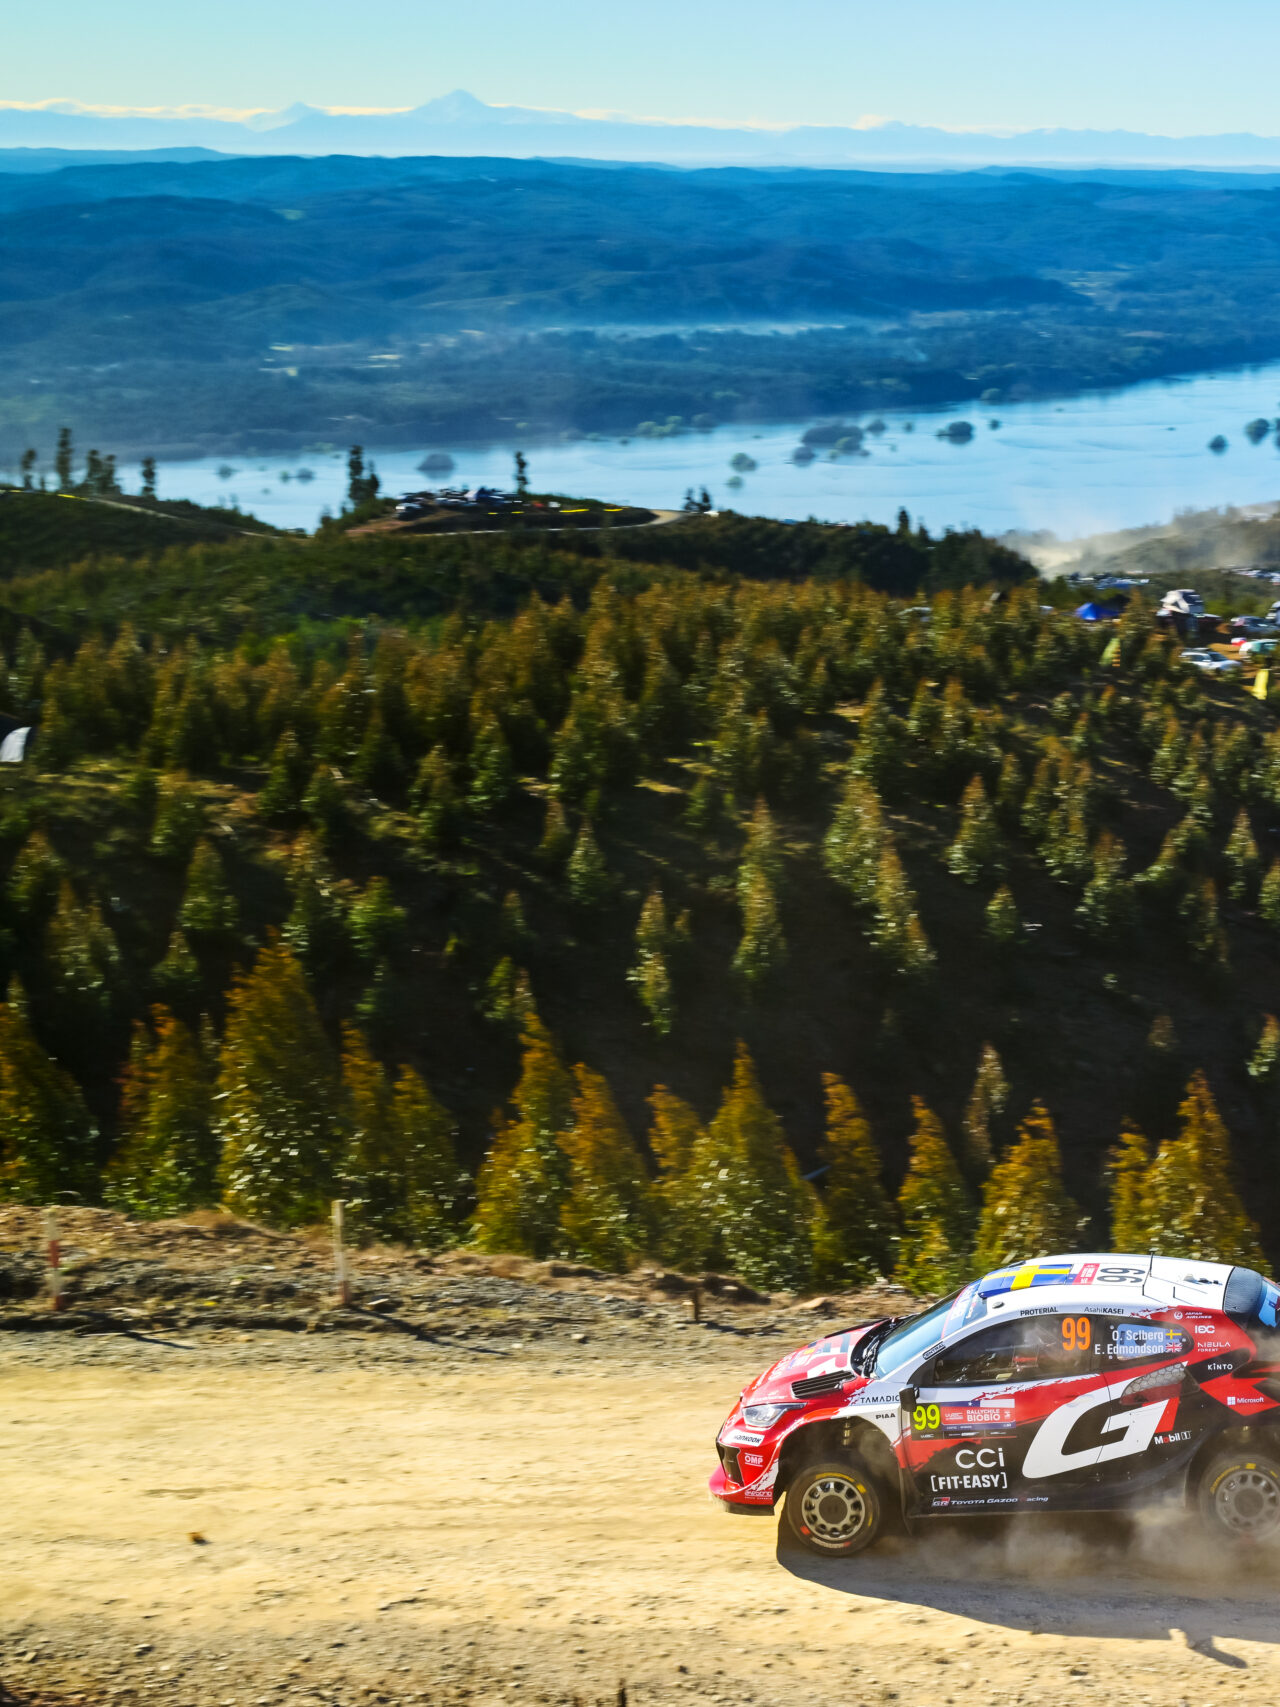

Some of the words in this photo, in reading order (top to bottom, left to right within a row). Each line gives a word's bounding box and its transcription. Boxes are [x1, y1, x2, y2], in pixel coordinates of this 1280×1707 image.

[1020, 1306, 1058, 1317] PROTERIAL
[1061, 1316, 1091, 1351] 99
[1111, 1330, 1123, 1341] O.
[1094, 1344, 1105, 1355] E.
[1107, 1343, 1164, 1355] Edmondson
[1237, 1396, 1265, 1404] Microsoft
[912, 1404, 941, 1431] 99
[966, 1413, 1001, 1422] BIOBIO
[1154, 1432, 1181, 1445] Mobil
[744, 1454, 763, 1465] OMP
